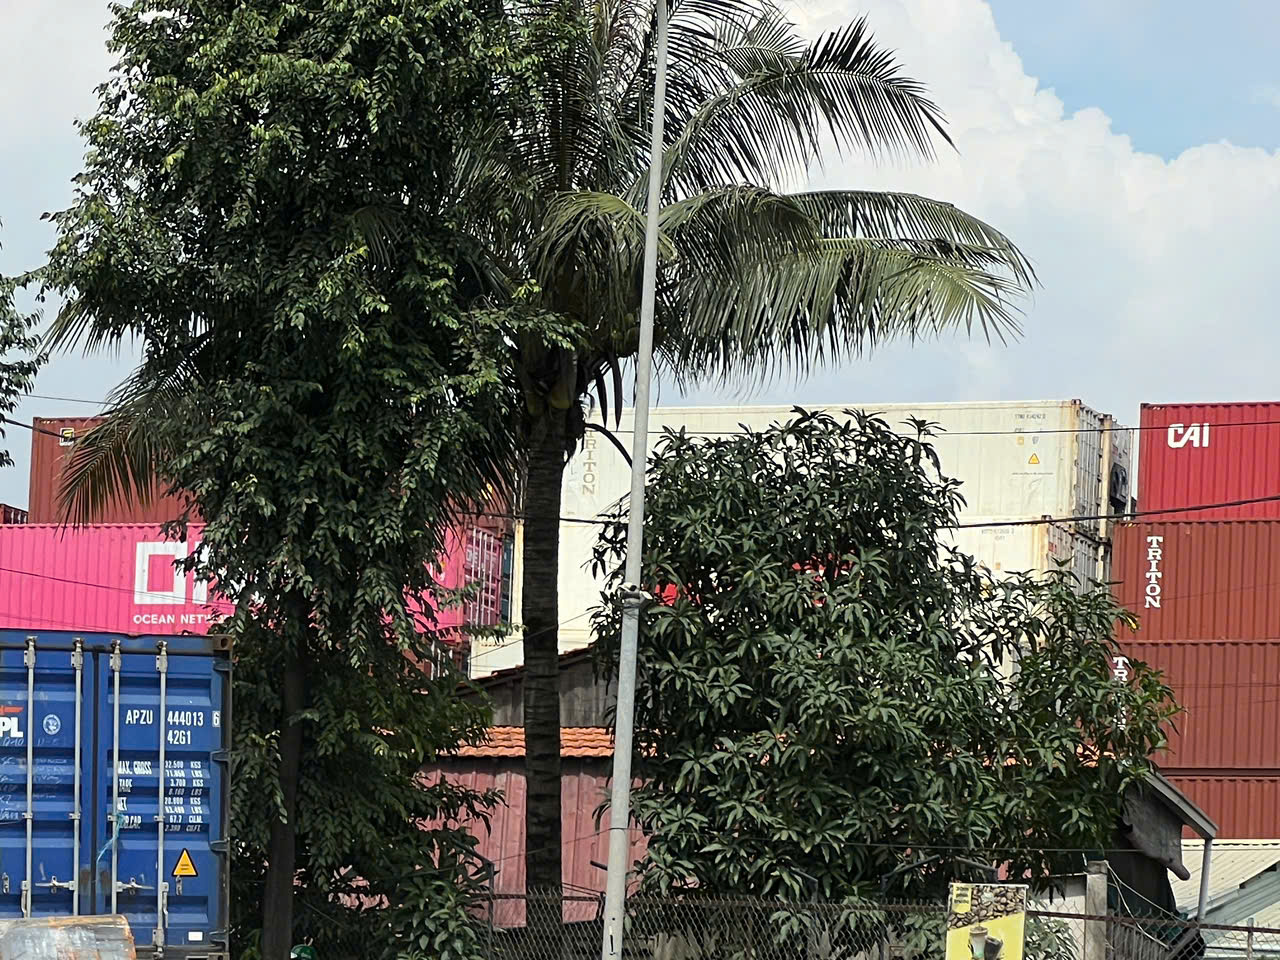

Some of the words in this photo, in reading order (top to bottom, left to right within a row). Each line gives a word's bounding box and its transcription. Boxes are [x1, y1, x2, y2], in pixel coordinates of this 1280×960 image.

[1167, 423, 1209, 448] CAI
[1144, 536, 1163, 608] TRITON
[133, 614, 175, 624] OCEAN
[125, 709, 153, 724] APZU
[167, 710, 204, 726] 444013
[213, 711, 220, 727] 6
[167, 729, 191, 744] 42G1
